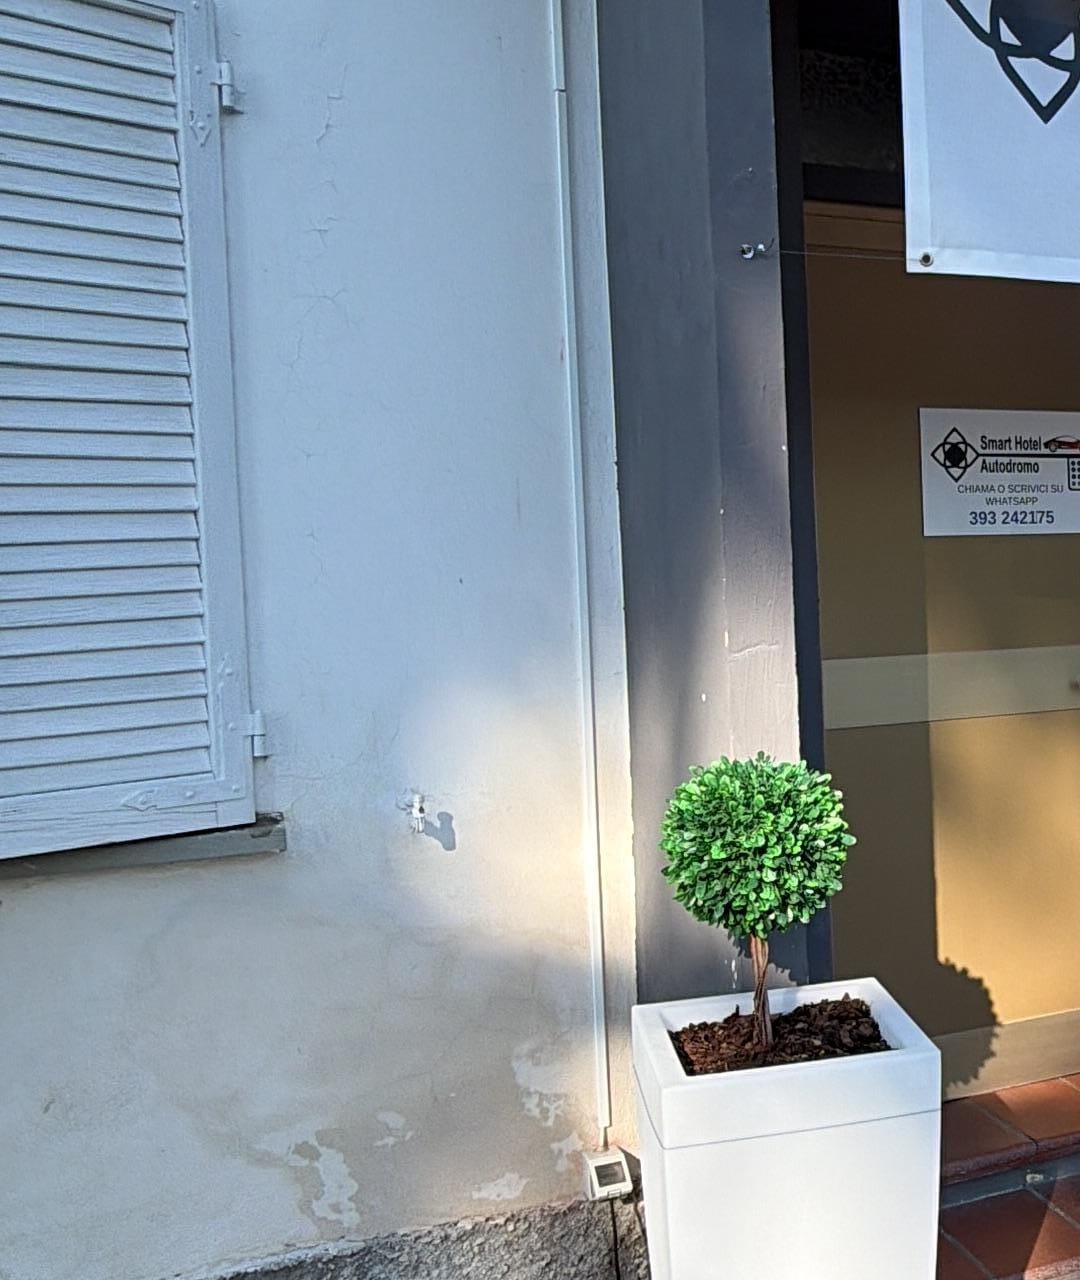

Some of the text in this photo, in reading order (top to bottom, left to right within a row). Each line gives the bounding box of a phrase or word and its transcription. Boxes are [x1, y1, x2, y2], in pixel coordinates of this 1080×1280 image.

[980, 435, 1042, 452] Smart Hotel
[980, 458, 1040, 474] Autodromo
[957, 484, 1064, 494] CHIAMA O SCRIVICI SU
[985, 496, 1039, 506] WHATSAPP
[969, 510, 1055, 526] 393 242175
